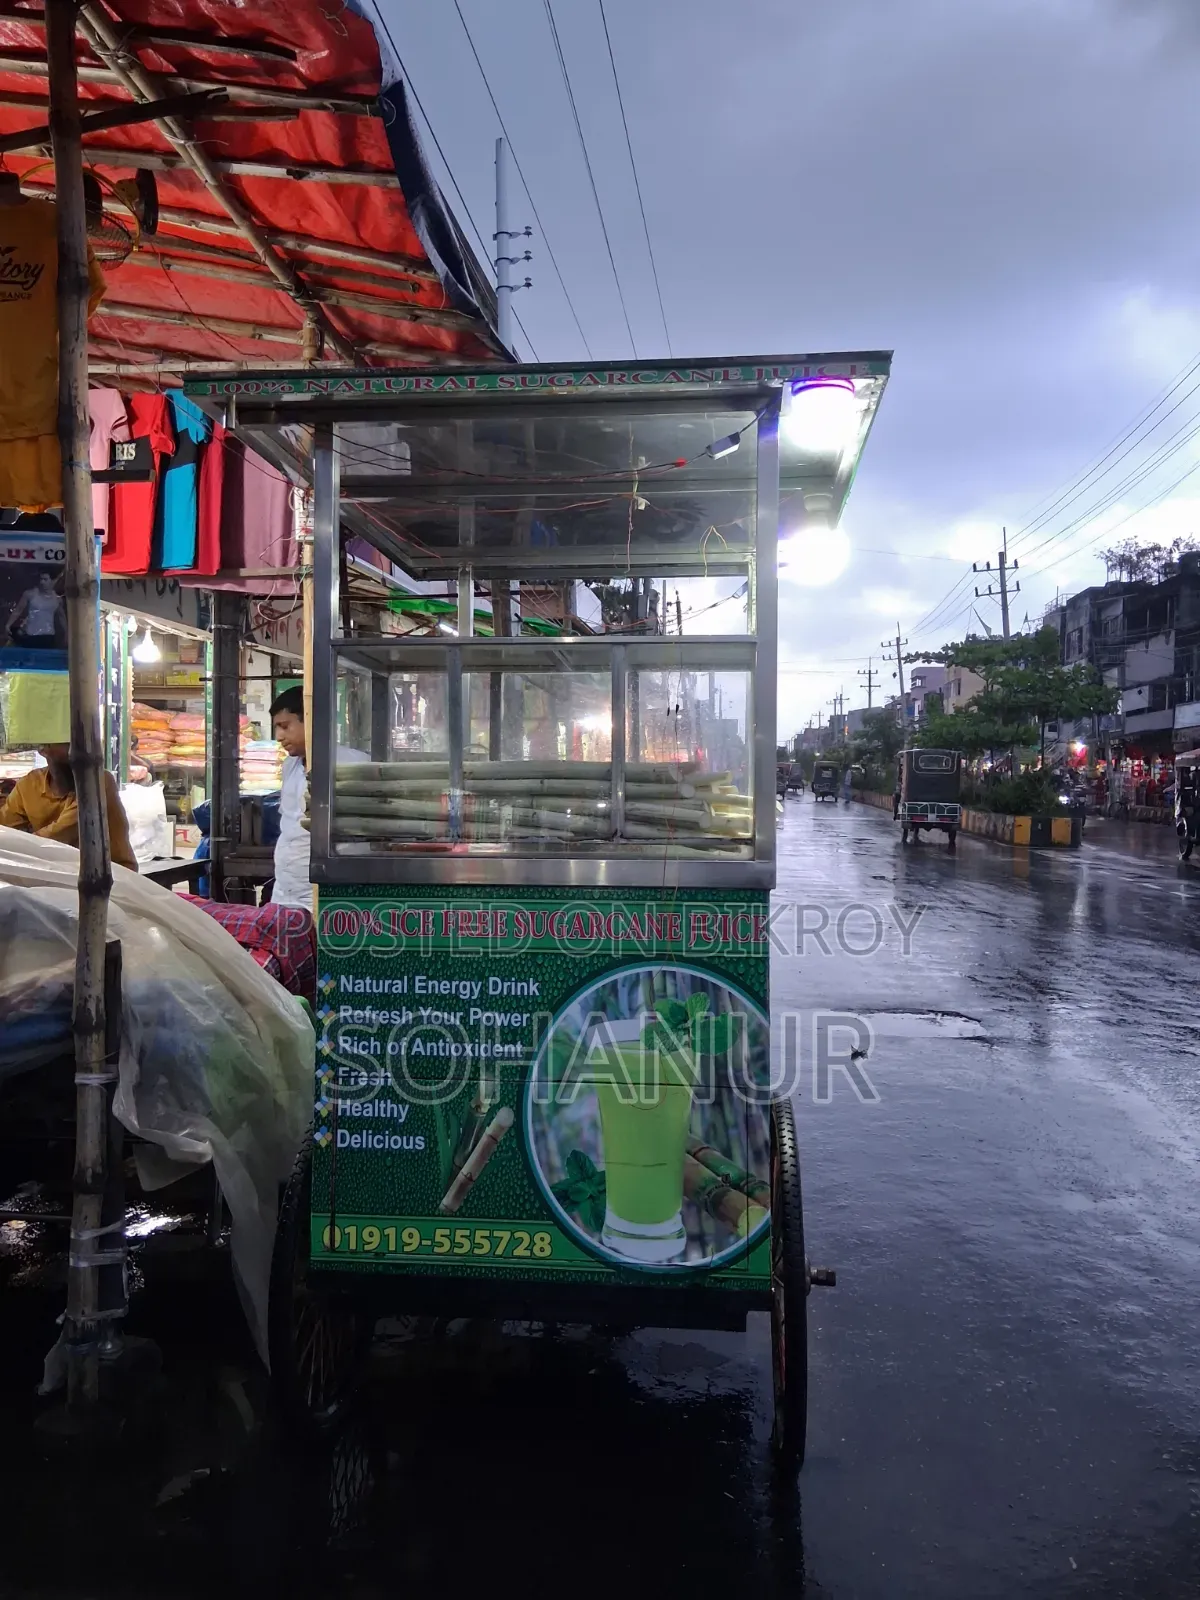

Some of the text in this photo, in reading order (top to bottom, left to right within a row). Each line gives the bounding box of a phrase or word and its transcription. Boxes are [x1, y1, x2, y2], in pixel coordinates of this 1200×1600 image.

[207, 364, 871, 396] 100% NATURAL SUGARCANE JUICE
[321, 908, 769, 948] 100% ICE FREE SUGARCANE JUICE
[339, 974, 540, 999] Natural Energy Drink
[338, 1004, 531, 1027] Refresh Your Power
[338, 1035, 524, 1058] Rich of Antioxident
[337, 1066, 393, 1086] Fresh
[336, 1099, 410, 1122] Healthy
[336, 1128, 425, 1150] Delicious
[322, 1224, 553, 1257] 01919-555728
